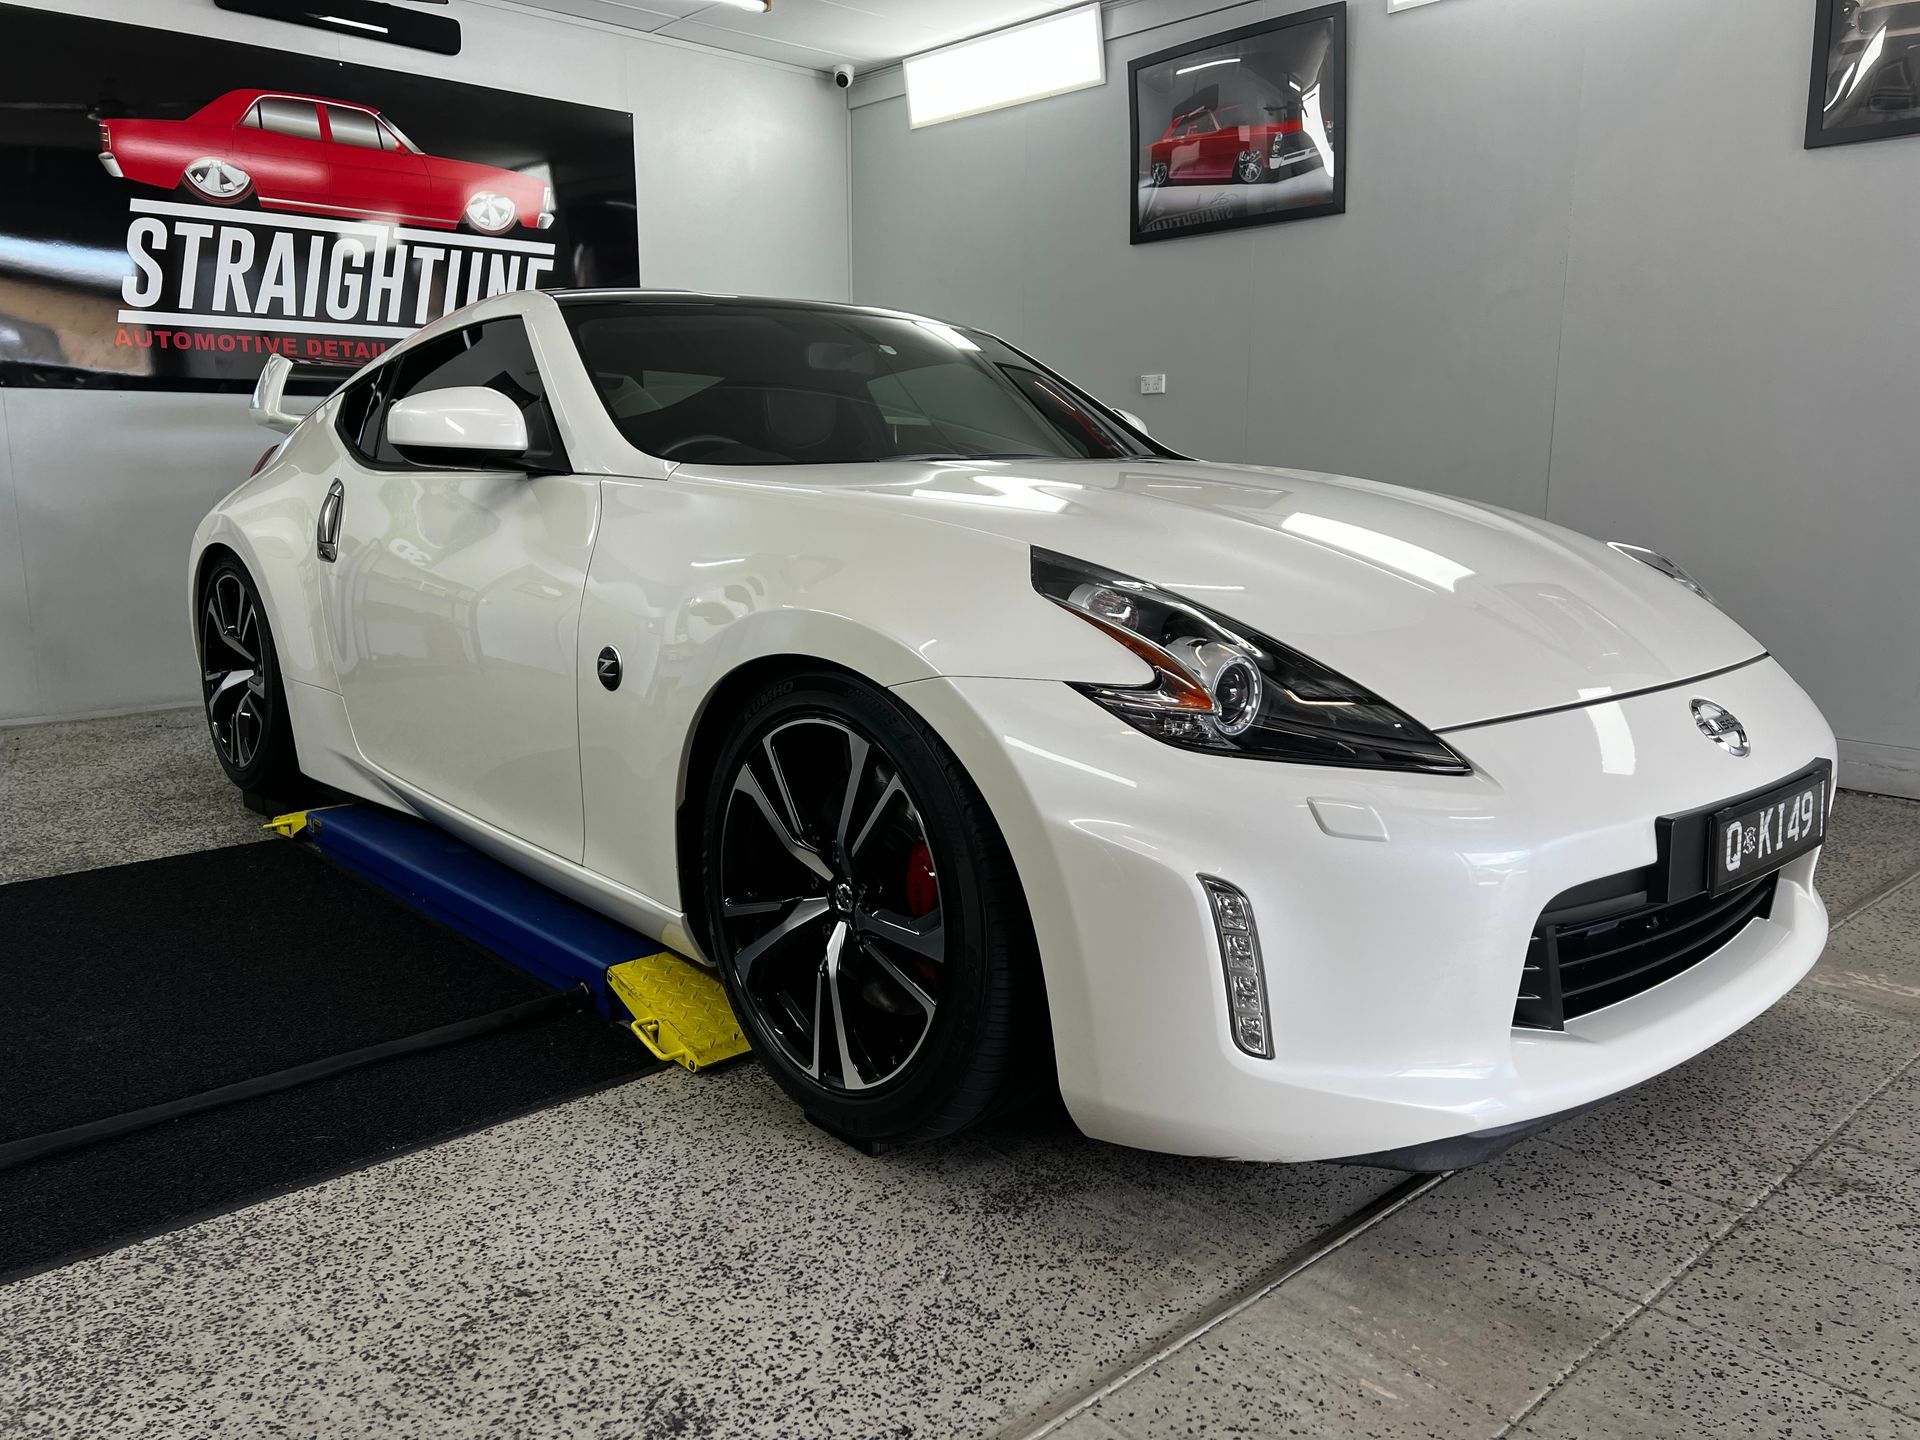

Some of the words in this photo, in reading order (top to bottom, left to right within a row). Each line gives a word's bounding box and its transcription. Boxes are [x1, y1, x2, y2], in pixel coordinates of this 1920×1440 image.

[114, 329, 298, 355] AUTOMOTIVE
[598, 657, 617, 677] Z
[743, 679, 794, 723] KUMHO
[1725, 821, 1743, 872] Q
[1757, 790, 1814, 860] KI49
